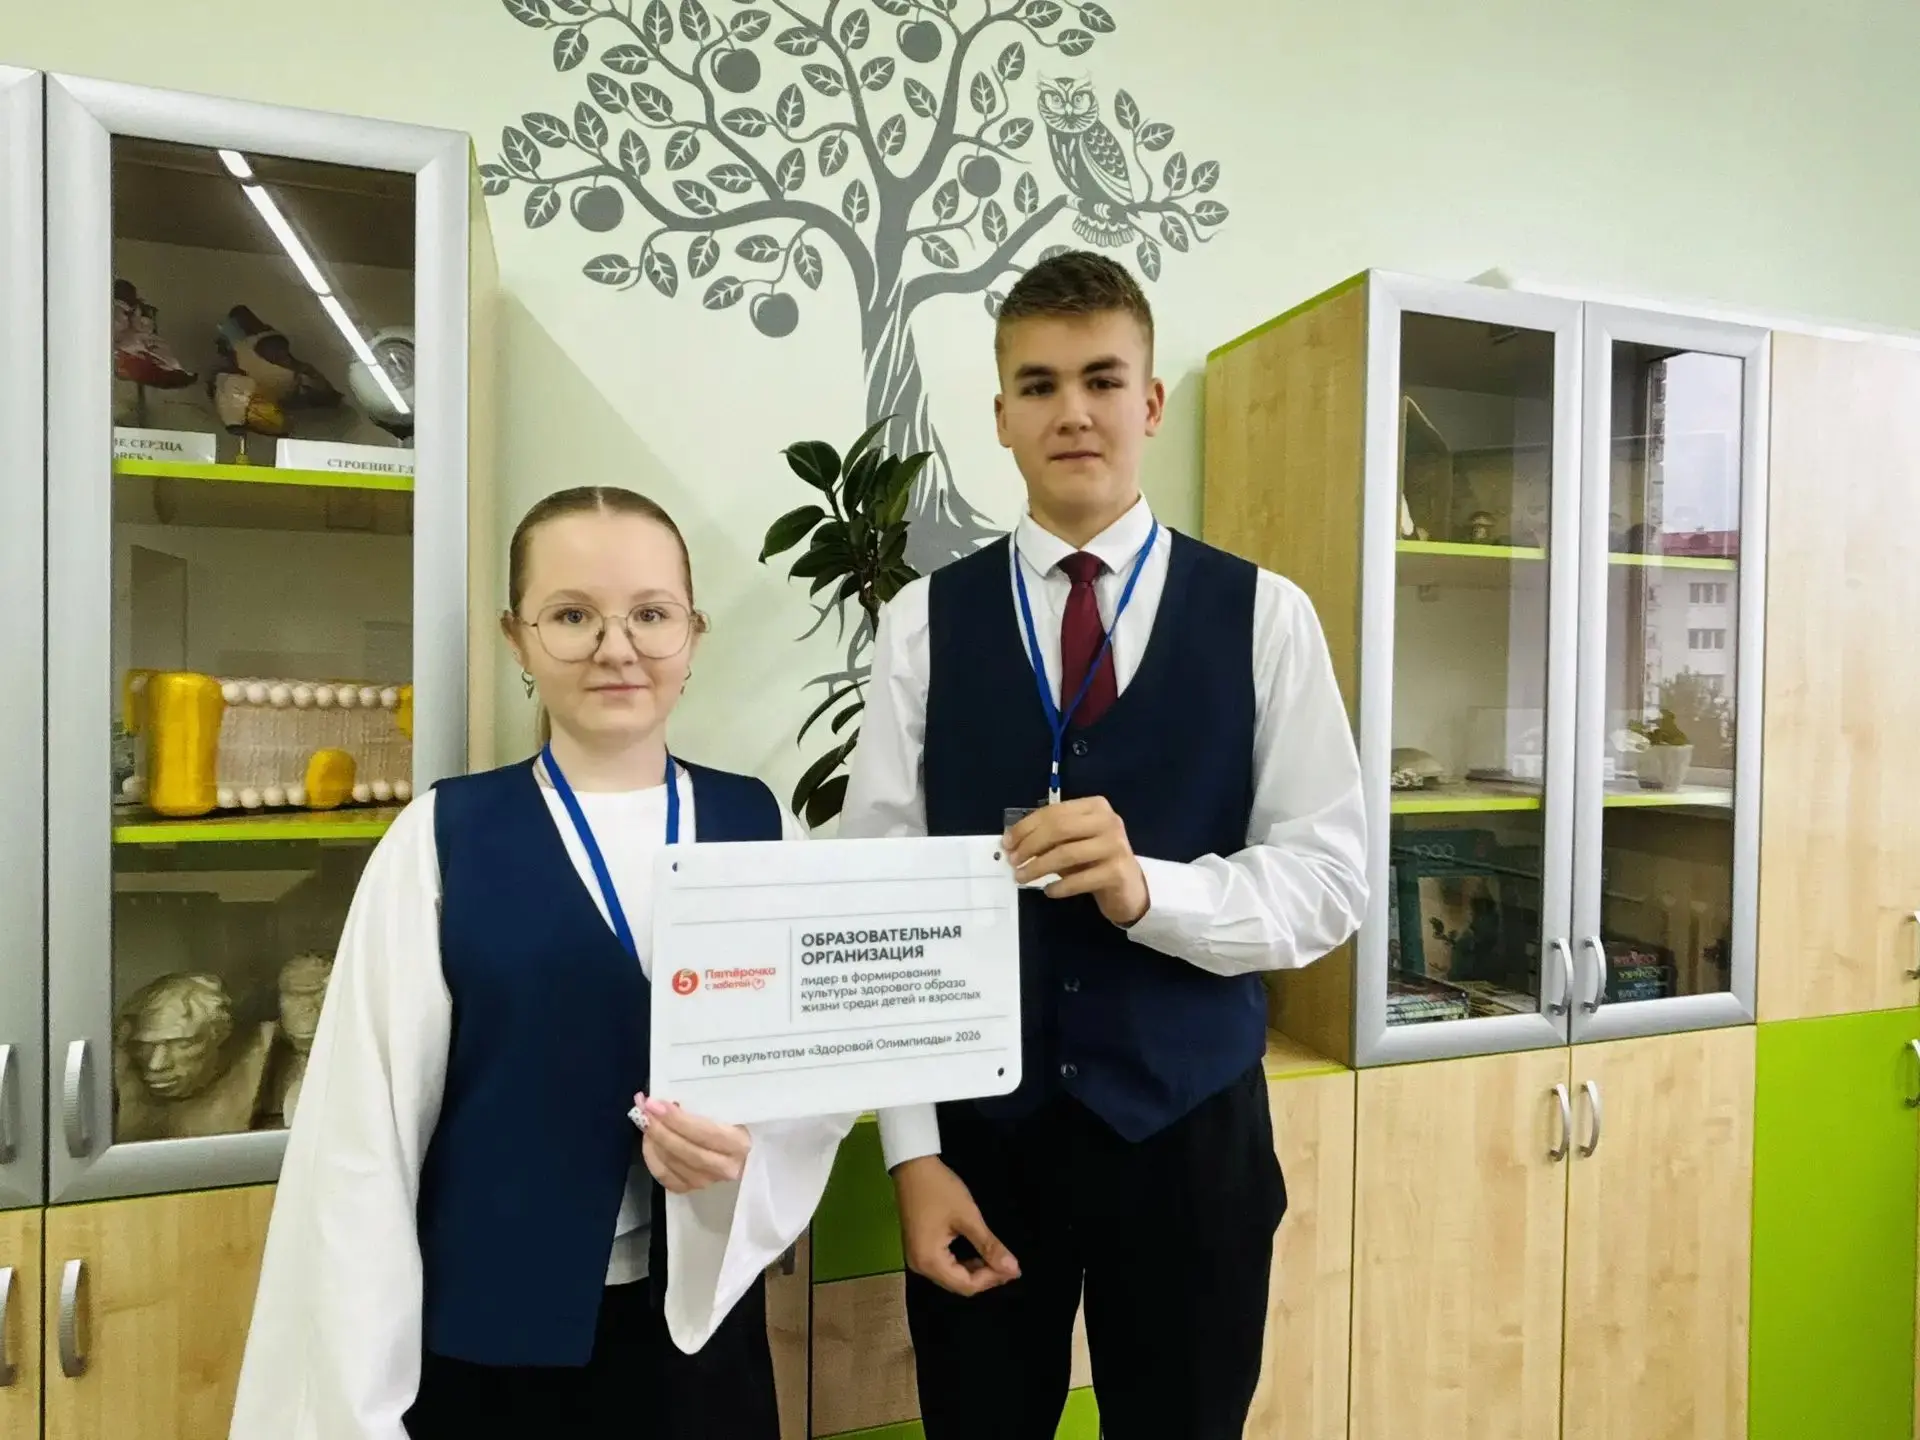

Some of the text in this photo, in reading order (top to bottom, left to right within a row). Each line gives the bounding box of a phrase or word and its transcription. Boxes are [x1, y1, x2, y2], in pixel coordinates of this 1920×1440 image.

[131, 438, 183, 451] СЕРДЦА
[327, 458, 394, 472] СТРОЕНИЕ
[801, 925, 962, 947] ОБРАЗОВАТЕЛЬНАЯ
[801, 945, 924, 965] ОРГАНИЗАЦИЯ
[704, 967, 776, 979] Пятёрочка
[801, 968, 941, 986] лидер в формировании
[712, 979, 751, 990] заботой
[801, 979, 966, 1001] культуры здорового образа
[801, 991, 981, 1013] жизни среди детей и взрослых
[702, 1030, 981, 1067] По результатам «Здоровой Олимпиады» 2026
